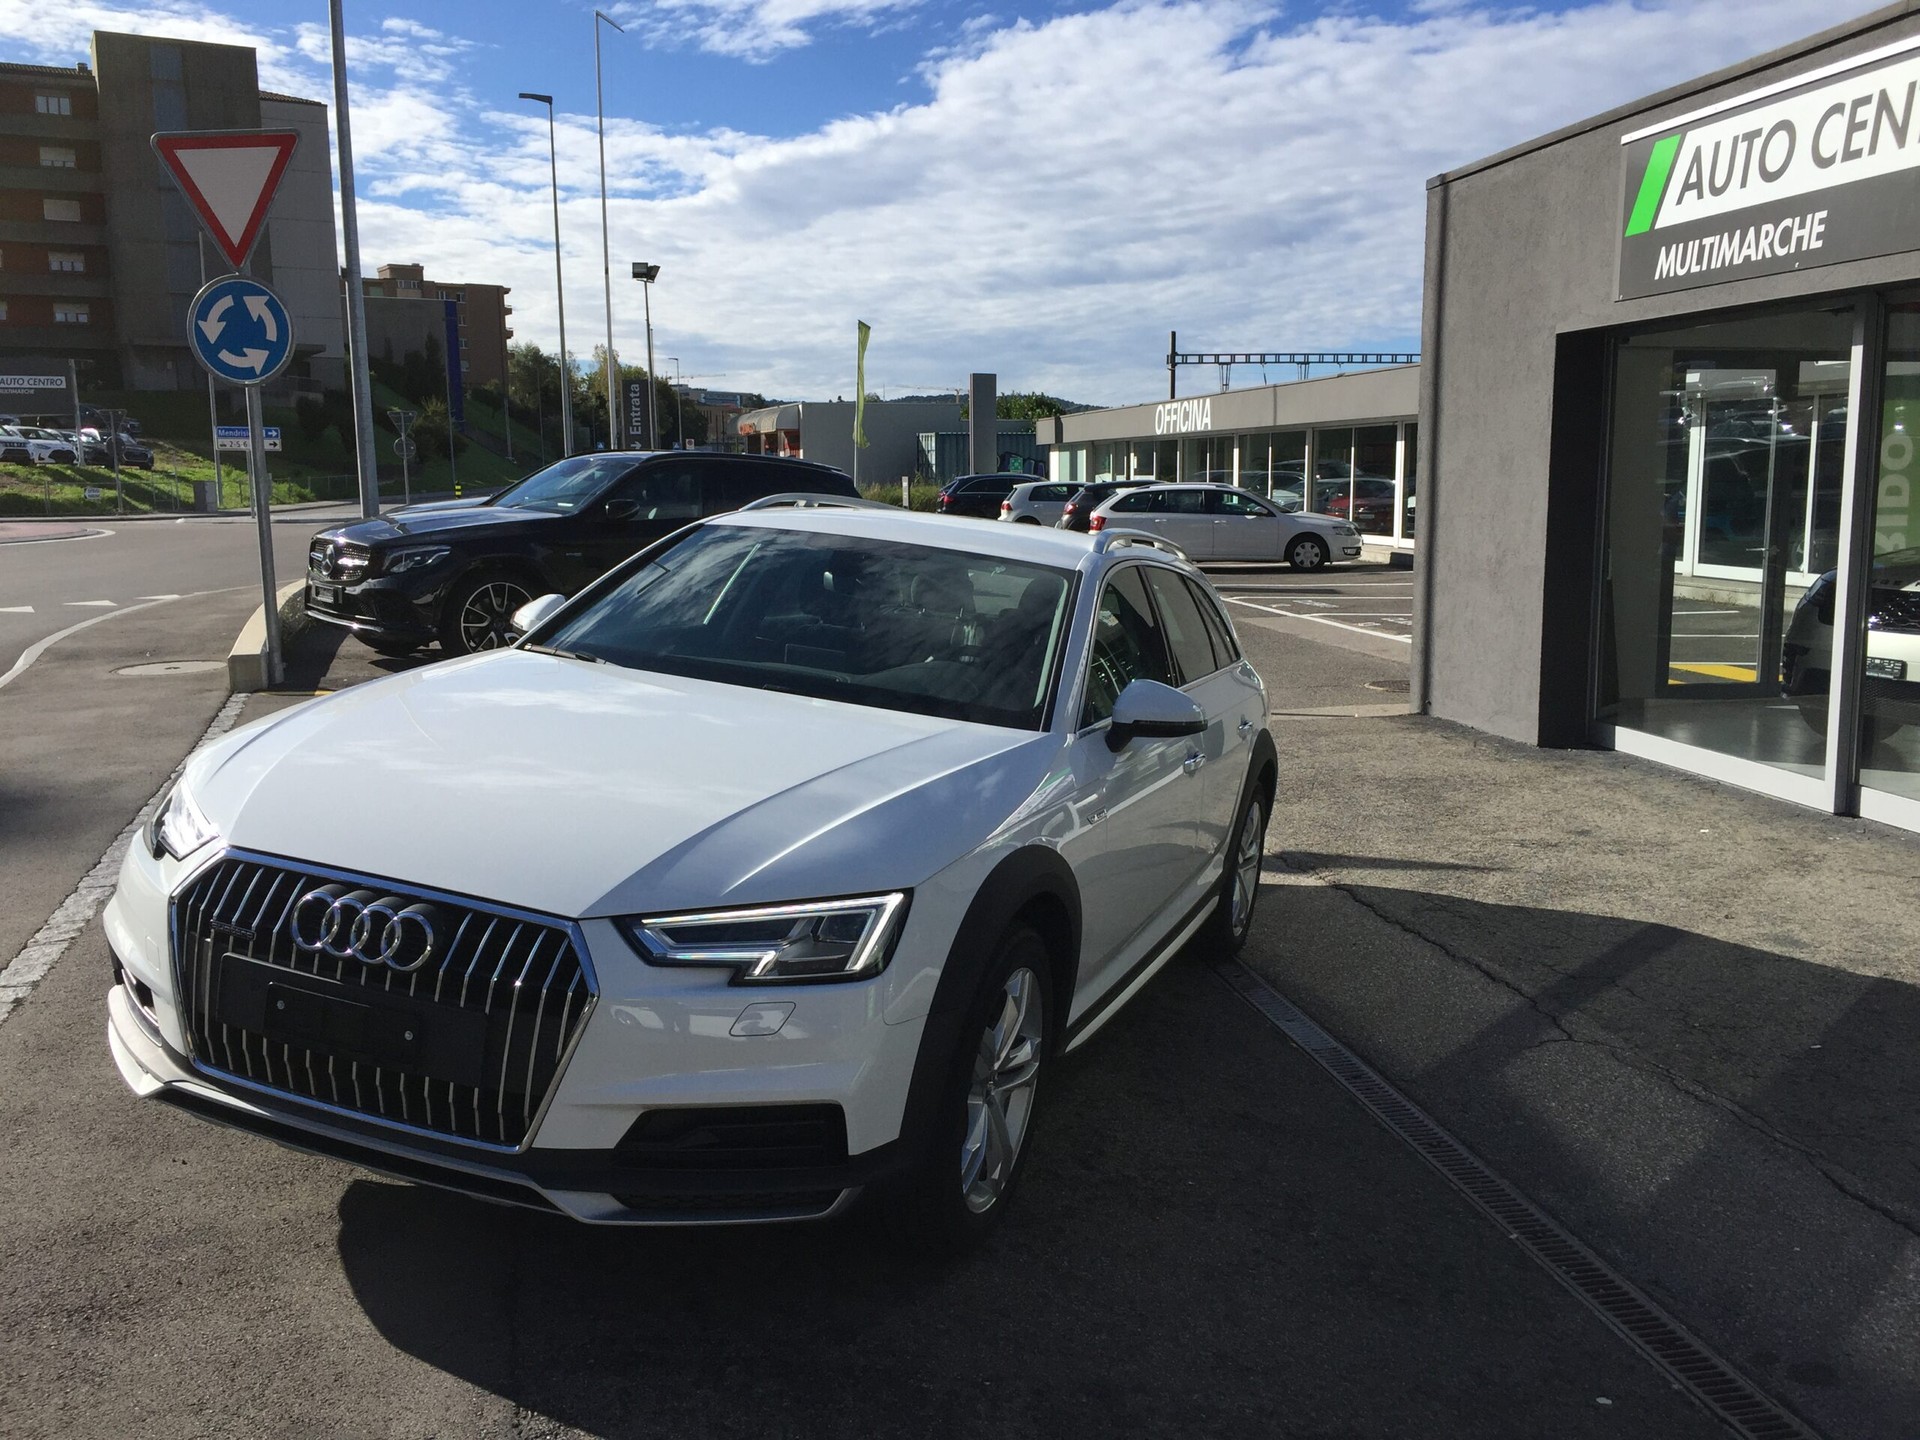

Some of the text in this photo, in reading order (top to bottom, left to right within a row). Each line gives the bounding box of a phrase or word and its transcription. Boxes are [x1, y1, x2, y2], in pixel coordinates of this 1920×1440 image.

[1675, 80, 1920, 206] AUTO CEN
[1654, 210, 1828, 281] MULTIMARCHE
[0, 377, 63, 387] AUTO CENTRO
[629, 383, 642, 435] Entrata
[1155, 398, 1212, 435] OFFICINA
[218, 429, 249, 437] Mendrisi
